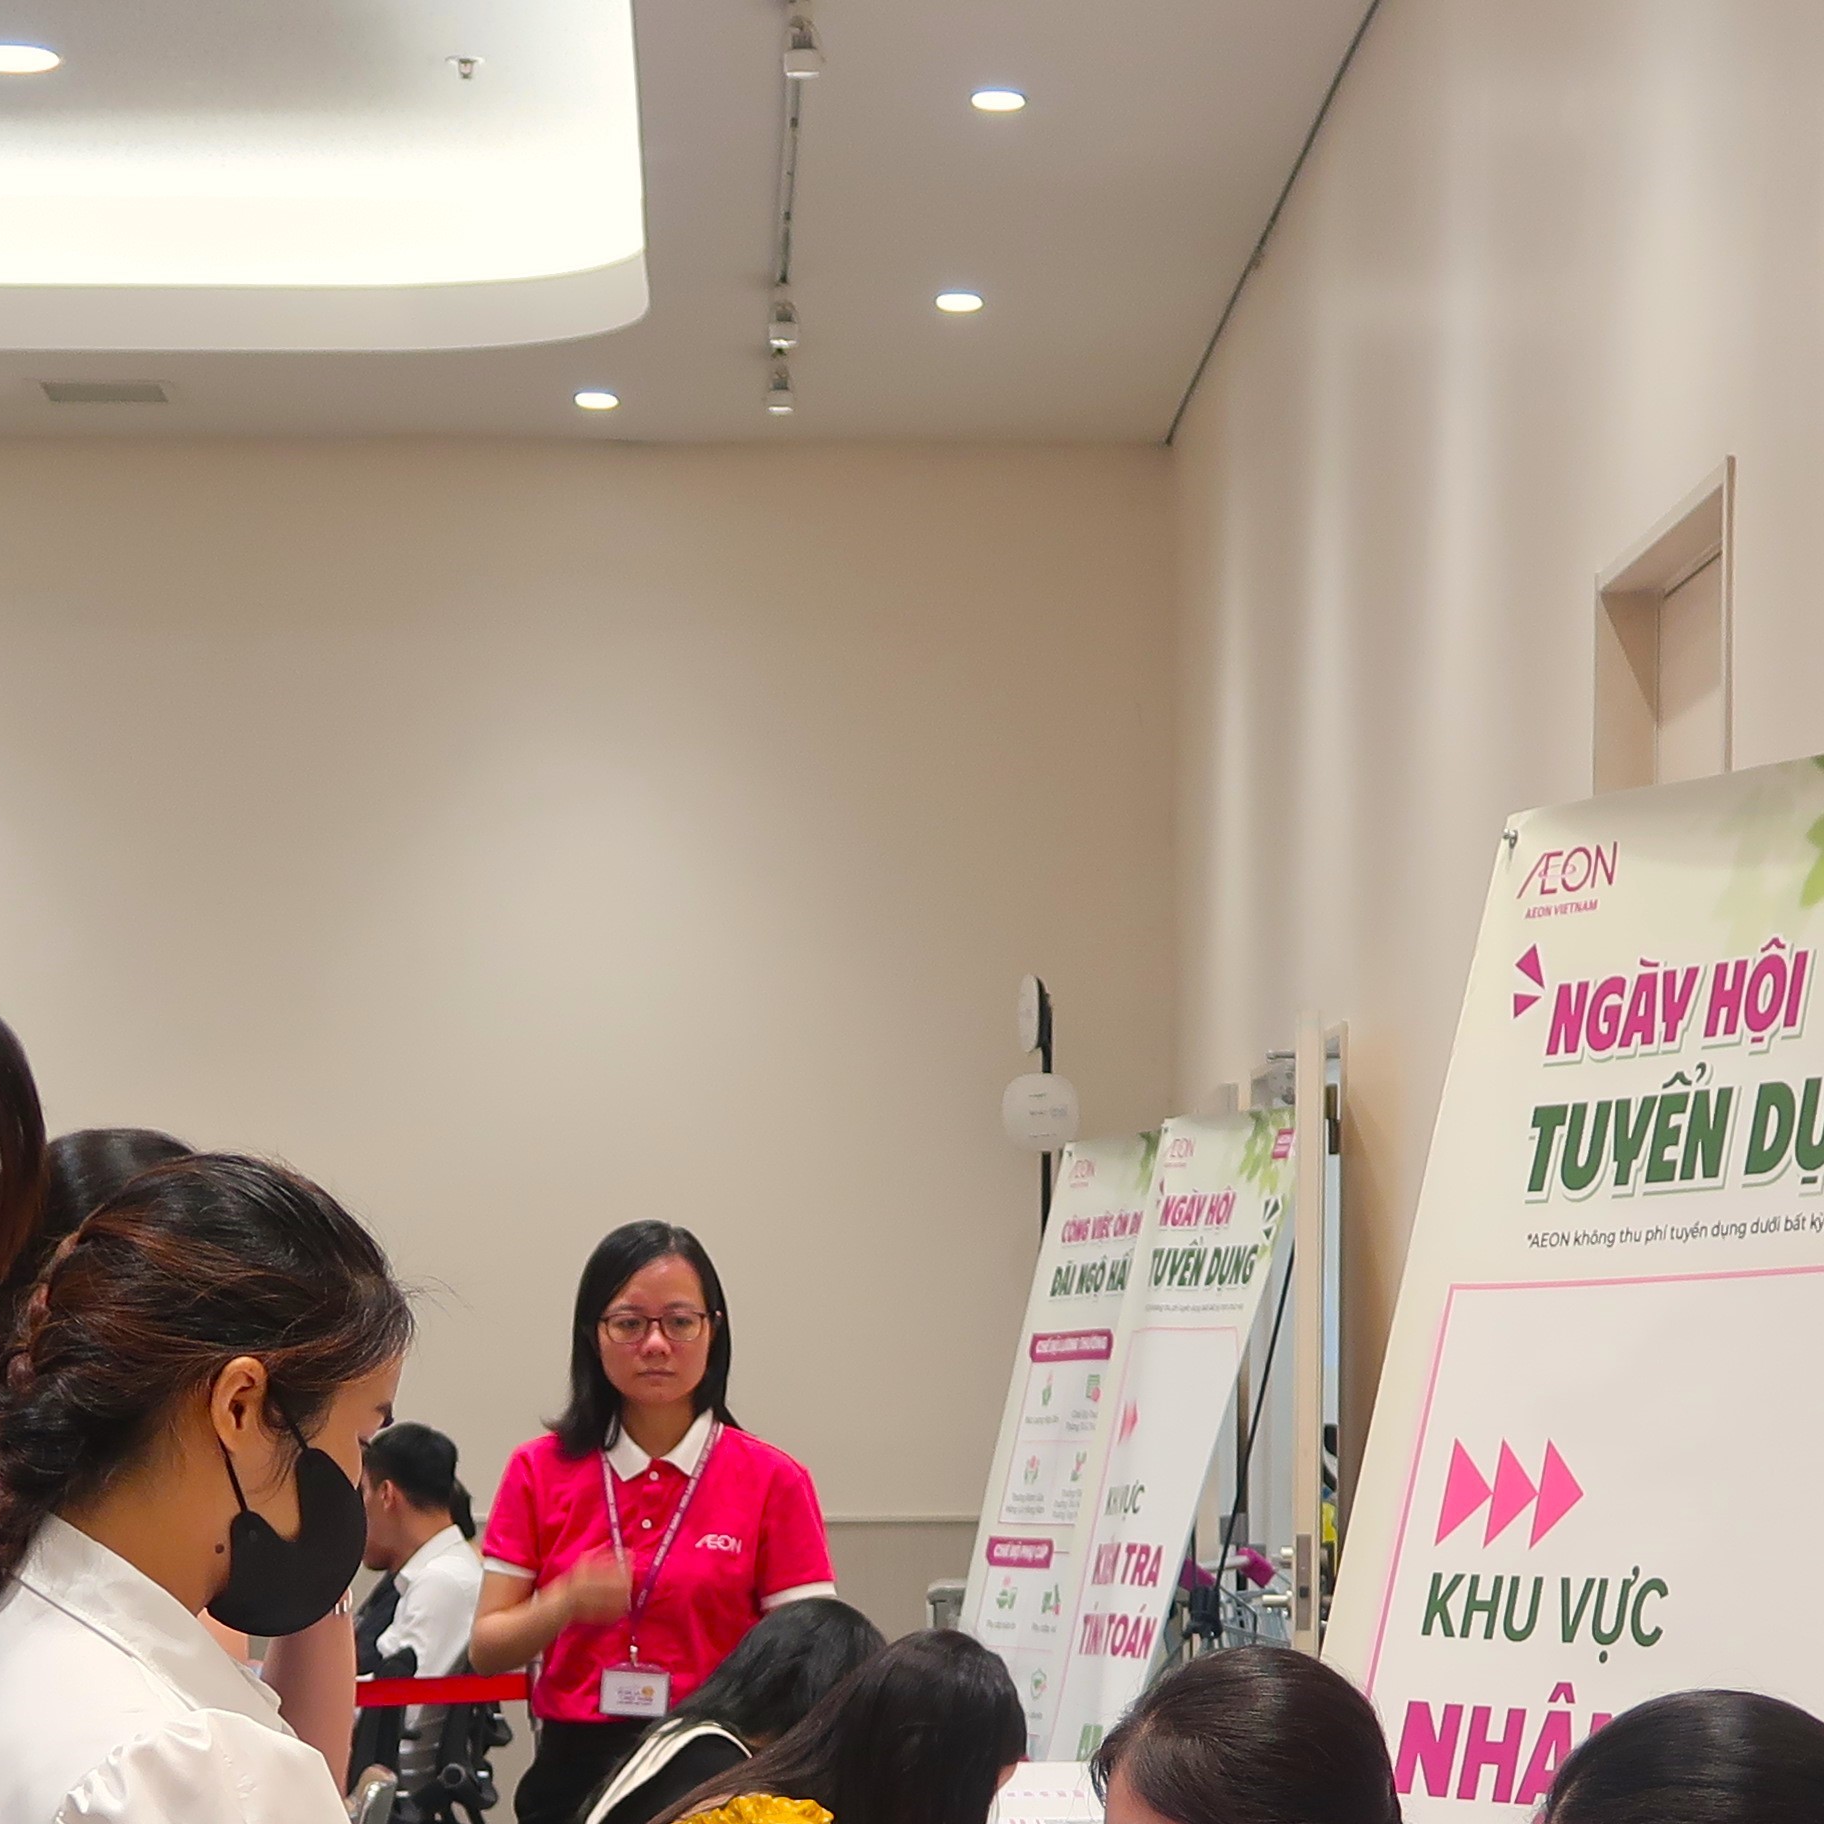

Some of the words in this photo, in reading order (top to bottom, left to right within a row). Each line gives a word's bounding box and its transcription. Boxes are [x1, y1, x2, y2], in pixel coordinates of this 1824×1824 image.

[1524, 906, 1552, 919] AEON
[1554, 899, 1598, 915] VIETNAM
[1545, 957, 1699, 1056] NGÀY
[1703, 936, 1810, 1043] HỘI
[1526, 1062, 1733, 1192] TUYỂN
[1160, 1189, 1206, 1226] NGÀY
[1205, 1186, 1236, 1229] HỘI
[1573, 1229, 1616, 1248] không
[1619, 1227, 1641, 1243] thu
[1645, 1225, 1668, 1245] phí
[1670, 1221, 1708, 1243] tuyển
[1711, 1220, 1747, 1240] dụng
[1750, 1216, 1781, 1234] dưới
[1784, 1212, 1806, 1231] bất
[1148, 1236, 1208, 1287] TUYỂN
[1205, 1244, 1259, 1291] DỤNG
[1121, 1542, 1163, 1587] TRA
[1103, 1604, 1157, 1659] TOÁN
[1421, 1570, 1544, 1643] KHU
[1560, 1565, 1670, 1664] VỰC
